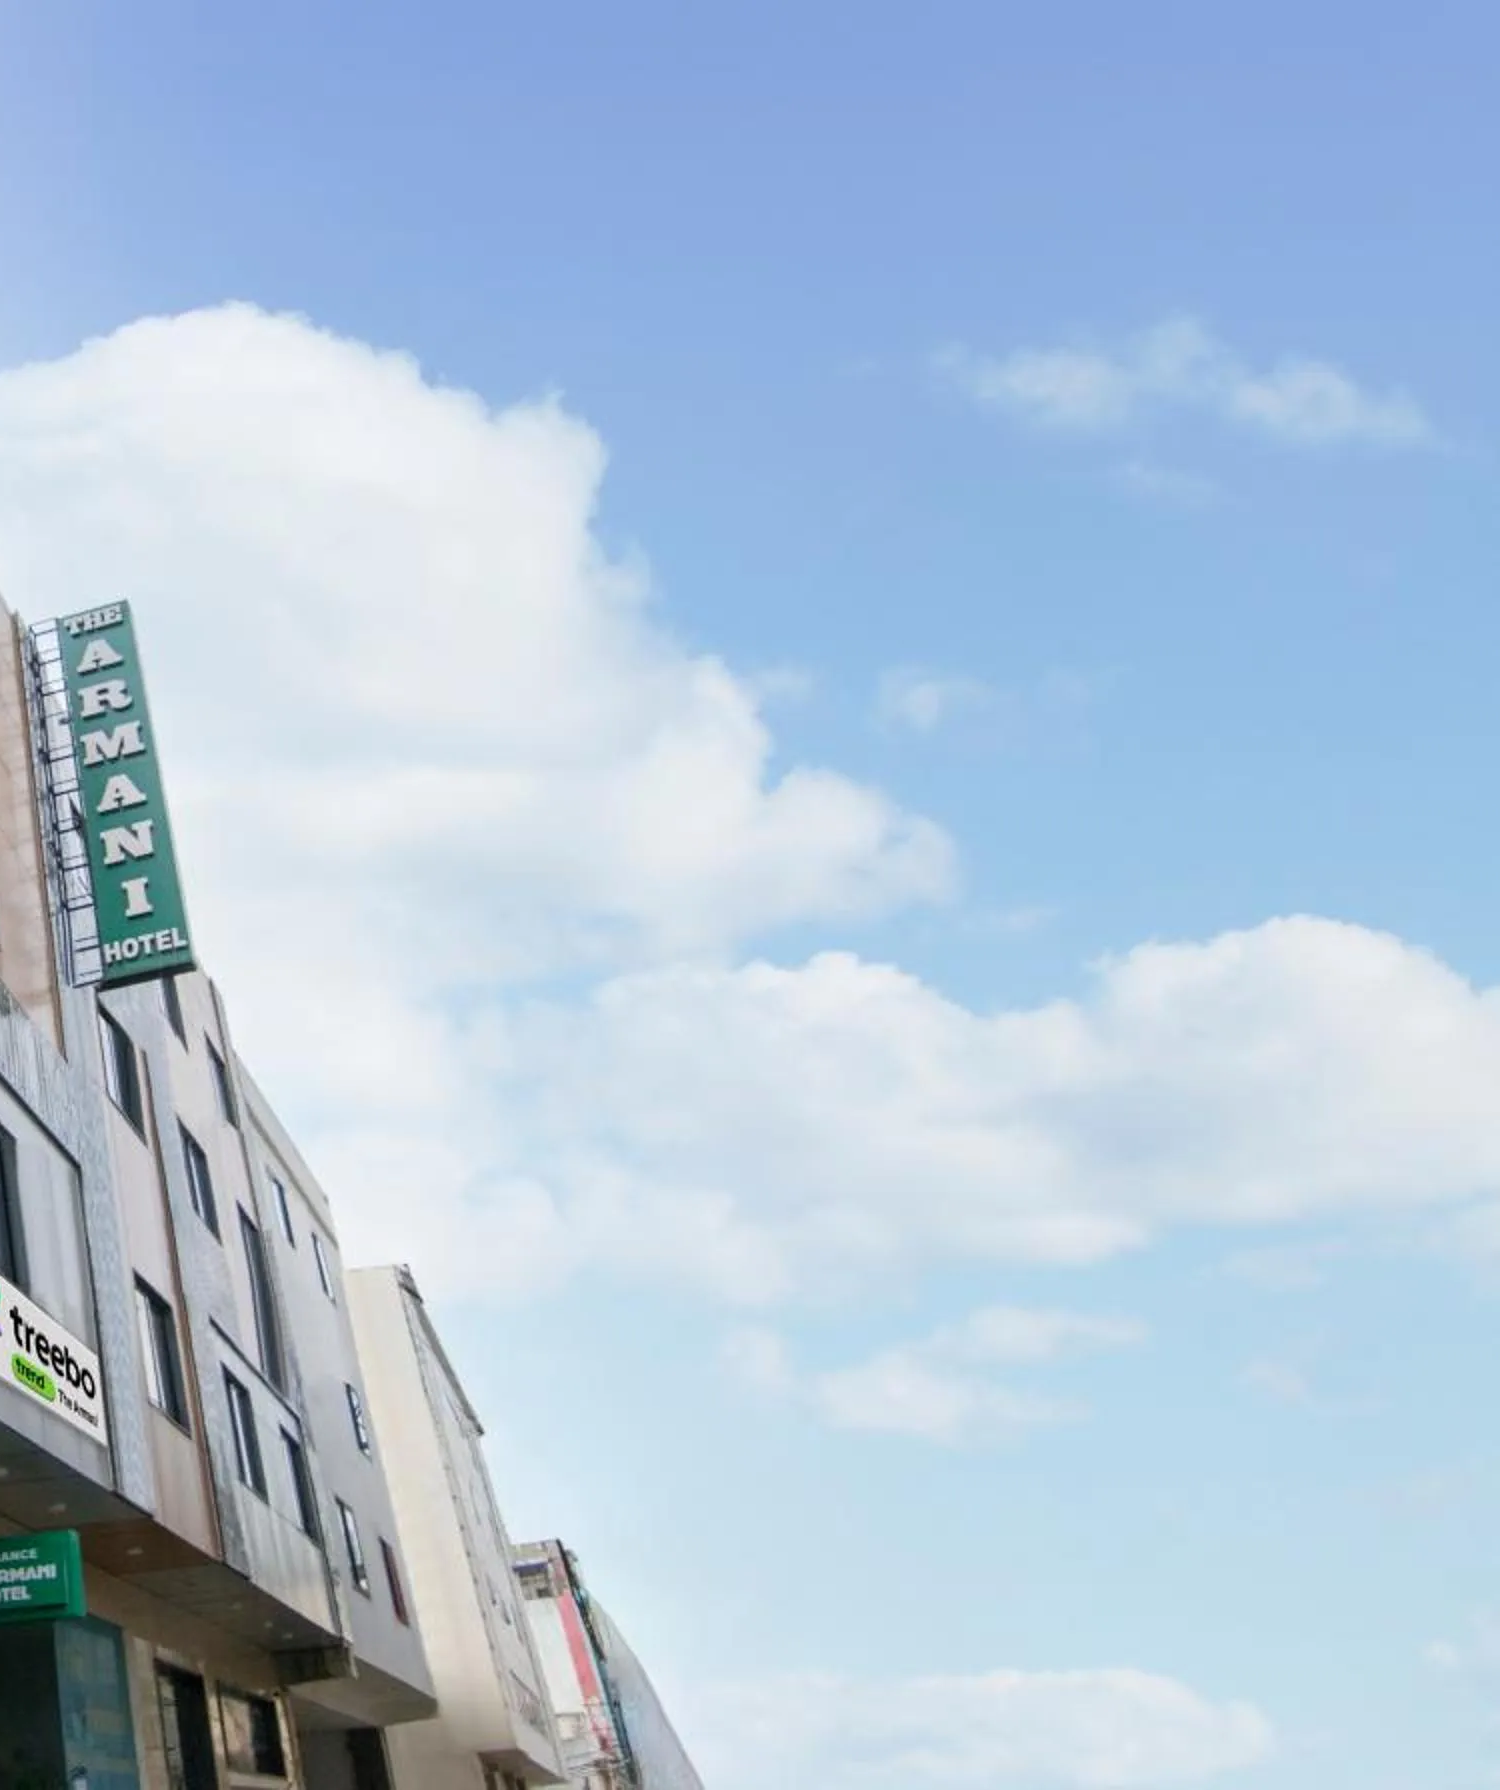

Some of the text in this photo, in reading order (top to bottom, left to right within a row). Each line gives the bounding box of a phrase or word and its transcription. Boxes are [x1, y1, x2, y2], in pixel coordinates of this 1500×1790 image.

[63, 603, 123, 636] THE
[76, 639, 155, 918] ARMANI
[103, 928, 188, 964] HOTEL
[9, 1305, 96, 1399] treebo
[15, 1357, 45, 1390] trend
